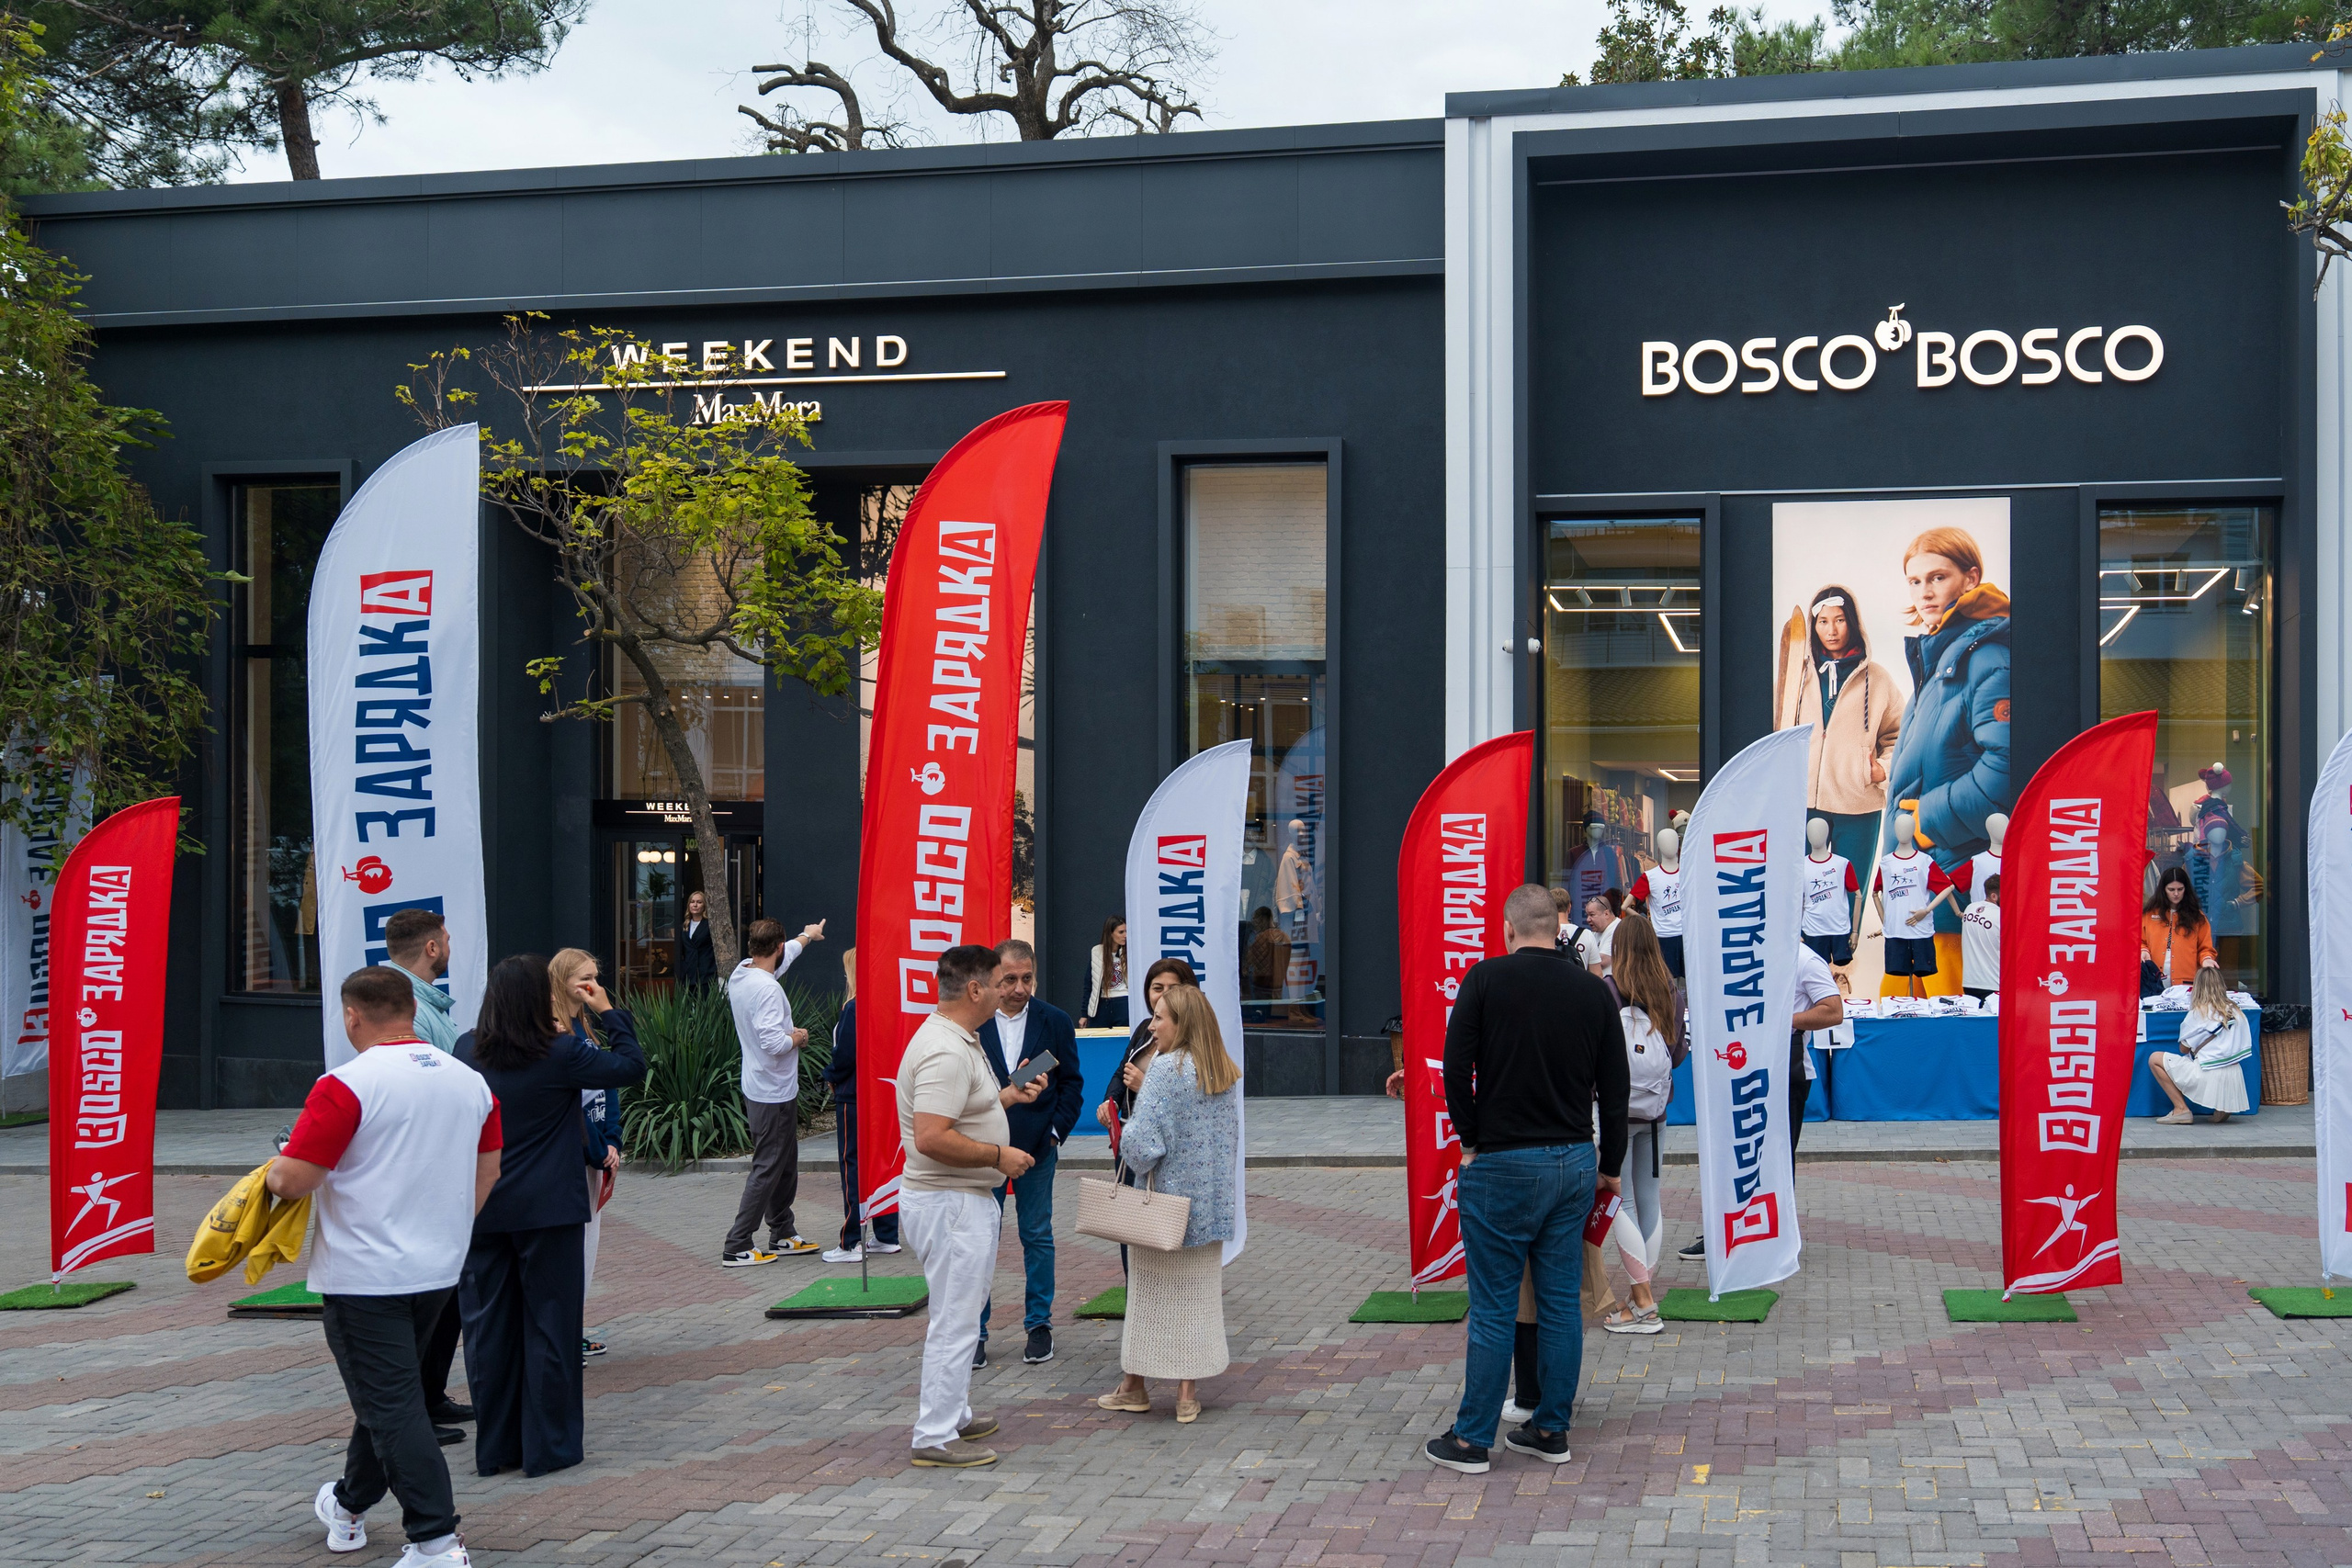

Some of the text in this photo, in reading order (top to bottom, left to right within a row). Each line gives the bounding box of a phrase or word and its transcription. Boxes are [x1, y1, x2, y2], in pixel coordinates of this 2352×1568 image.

[611, 334, 910, 373] WEEKEND
[1642, 325, 2164, 397] BOSCO BOSCO
[355, 570, 435, 843] ЗАРЯДКА
[928, 521, 996, 754] ЗАРЯДКА
[646, 802, 712, 811] WEEKE
[1441, 813, 1487, 970] ЗАРЯДКА
[1663, 904, 1681, 916] ЗАРЯДК
[1713, 829, 1768, 1032] ЗАРЯДКА
[75, 865, 132, 1149] BOSCO ЗАРЯДКА
[1828, 1030, 1840, 1045] L
[2038, 798, 2101, 1154] BOSCO ЗАРЯДКА
